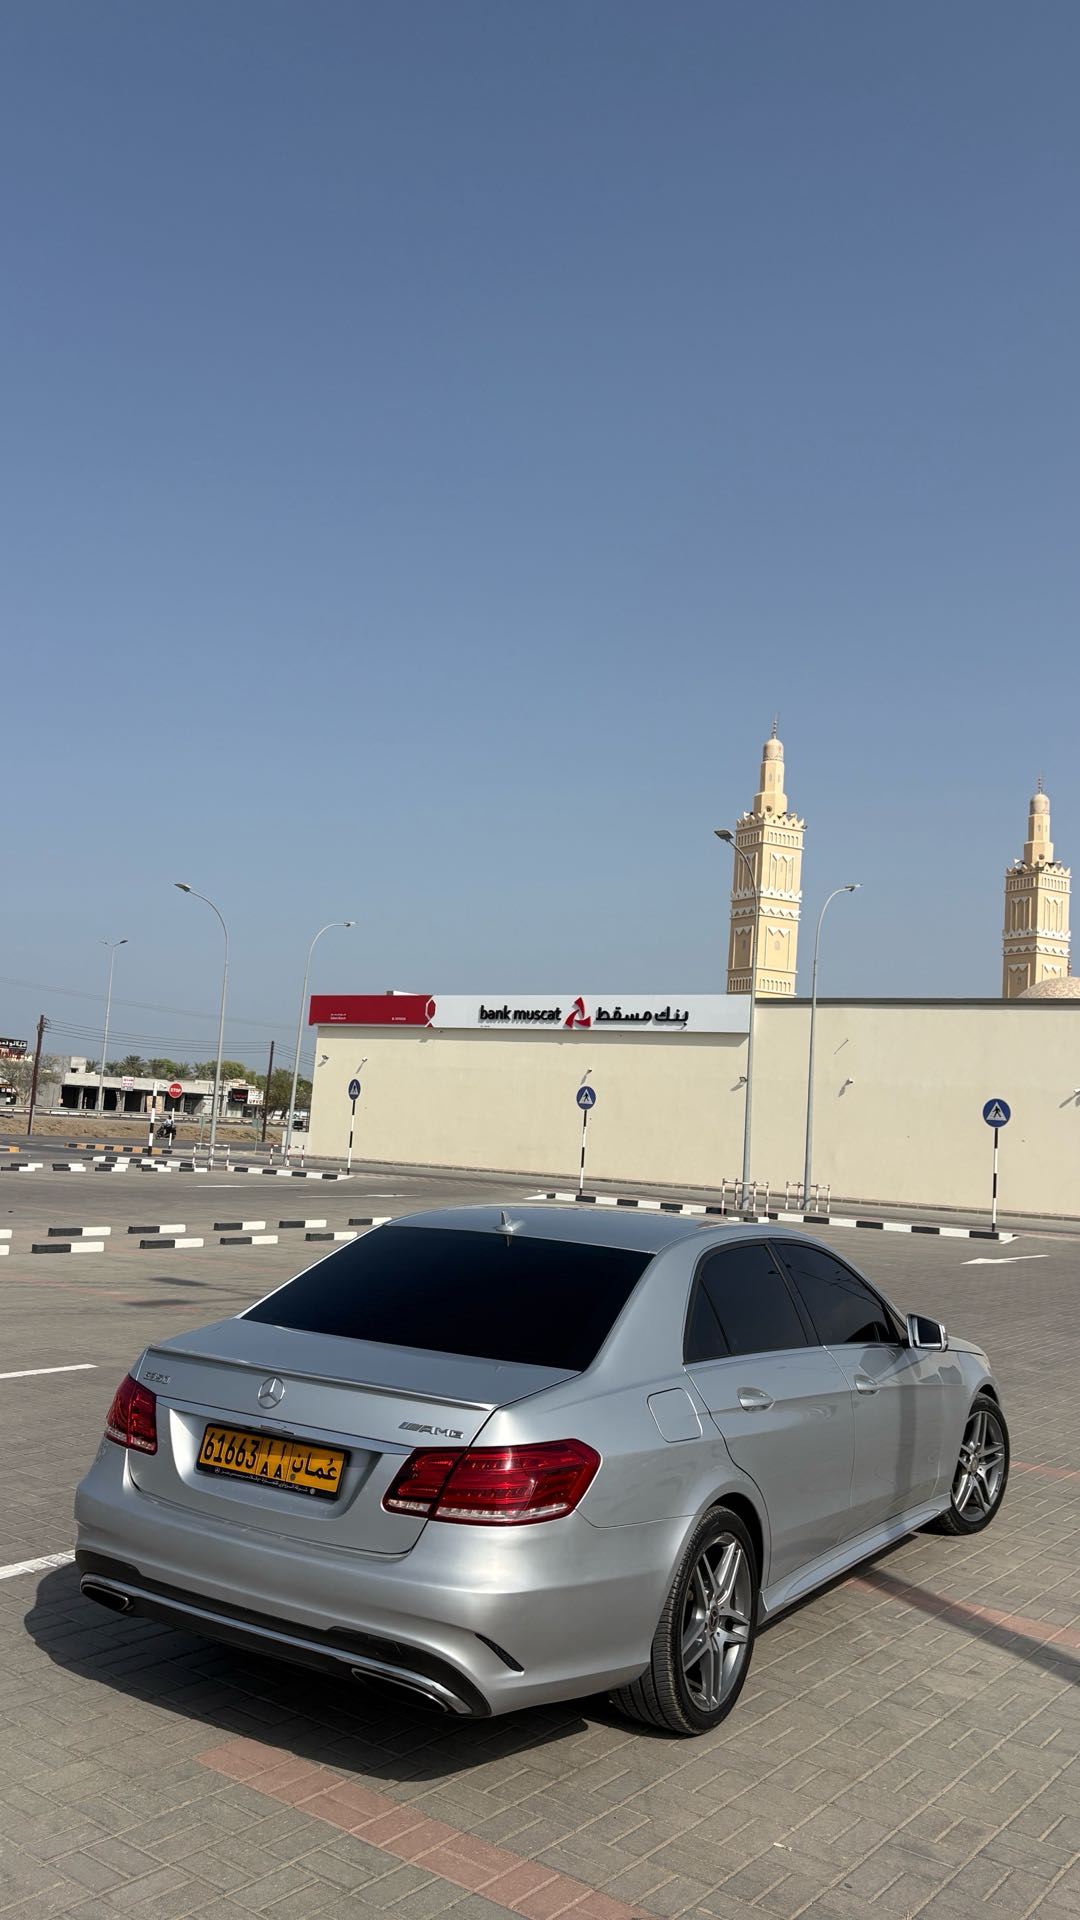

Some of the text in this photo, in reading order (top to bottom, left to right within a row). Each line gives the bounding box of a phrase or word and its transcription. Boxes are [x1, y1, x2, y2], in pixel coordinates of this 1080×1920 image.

[480, 1004, 562, 1021] bank muscat
[595, 1006, 689, 1026] بنك مسقط
[418, 1425, 464, 1439] AMG
[203, 1432, 260, 1469] 61663
